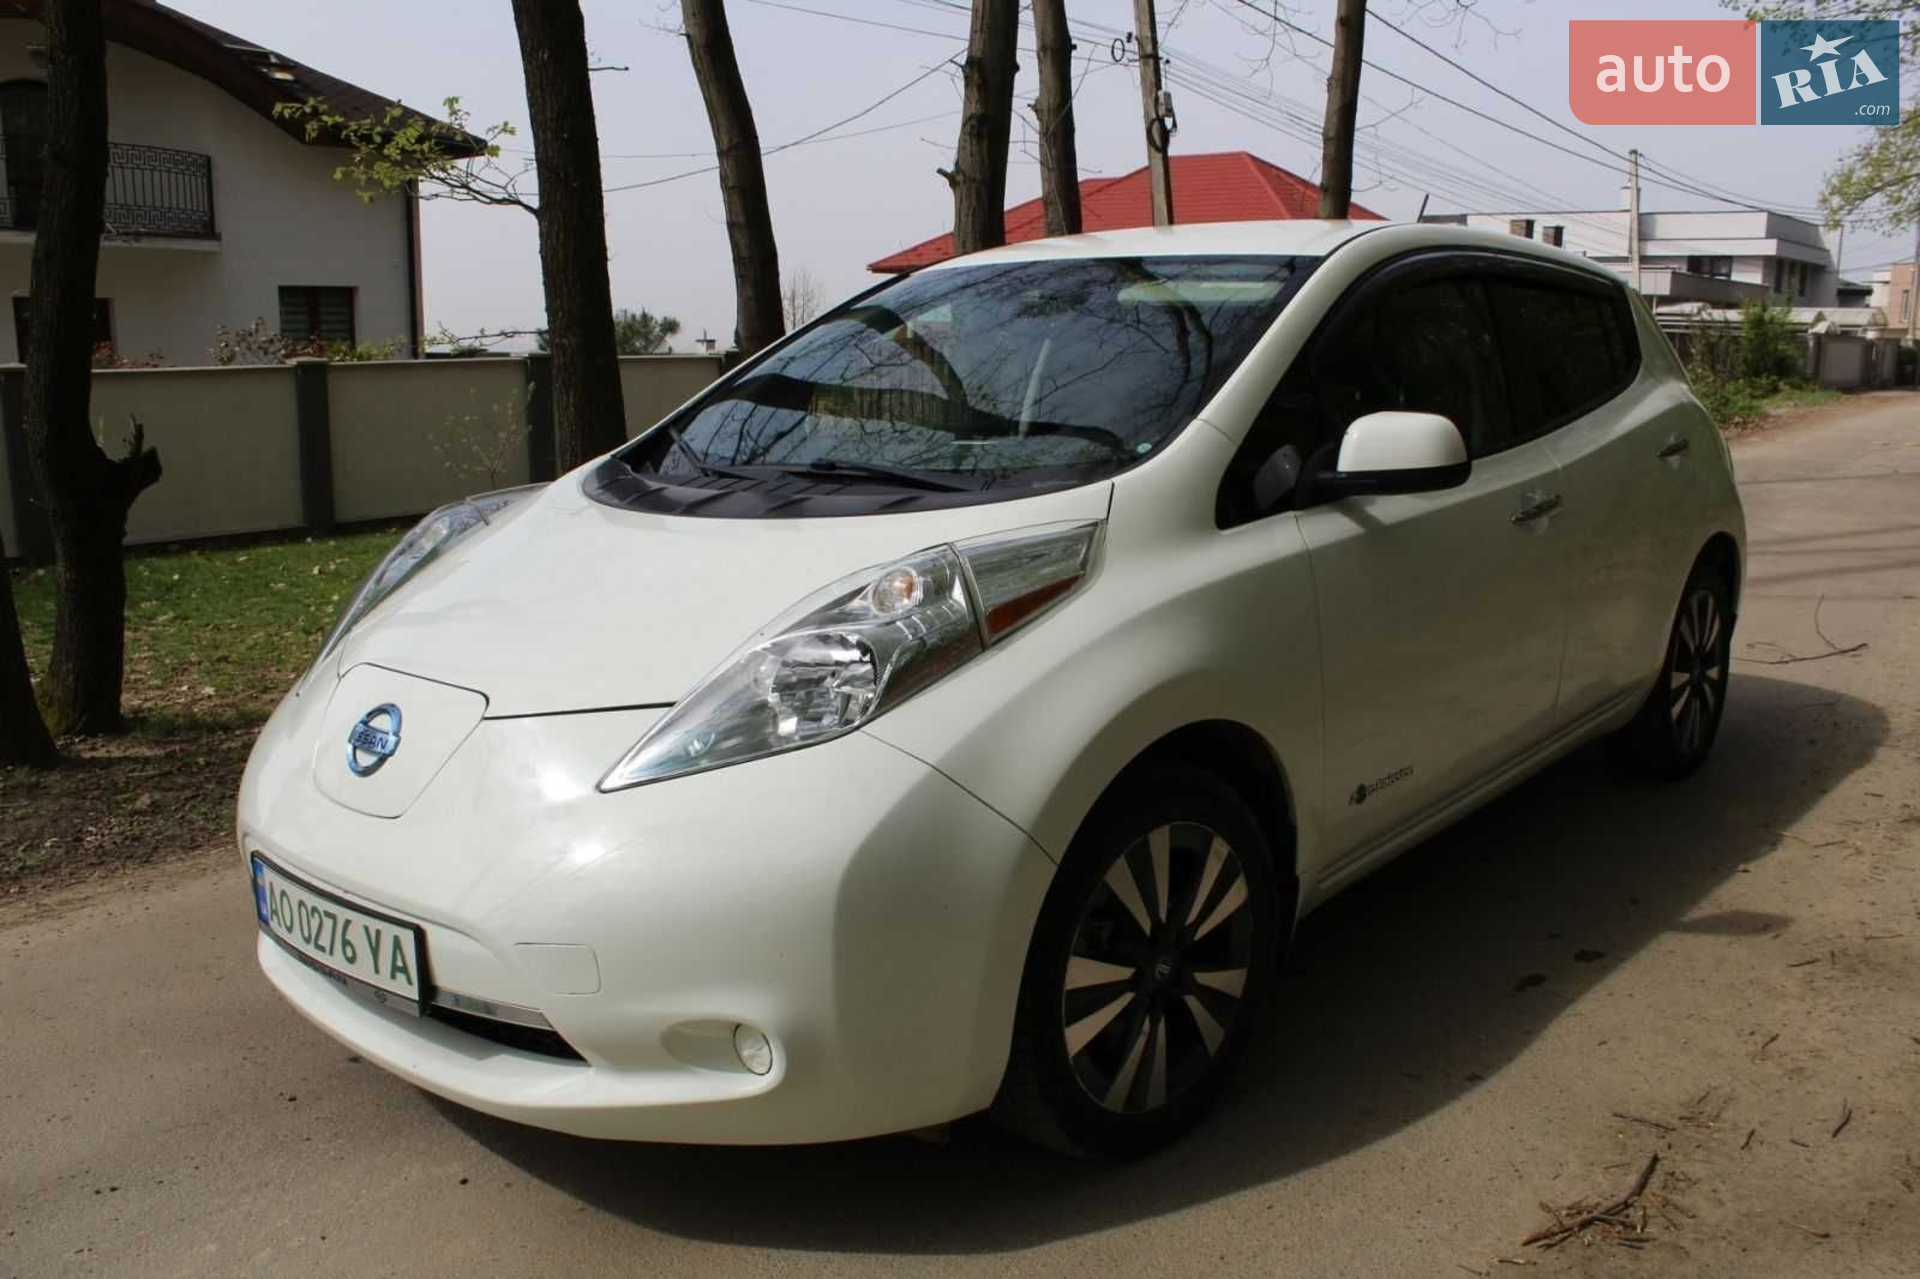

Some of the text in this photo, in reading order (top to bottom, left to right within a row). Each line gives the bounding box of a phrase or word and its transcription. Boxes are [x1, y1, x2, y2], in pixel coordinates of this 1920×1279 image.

[269, 881, 294, 934] AO
[298, 899, 357, 965] 0276
[363, 924, 413, 986] YA
